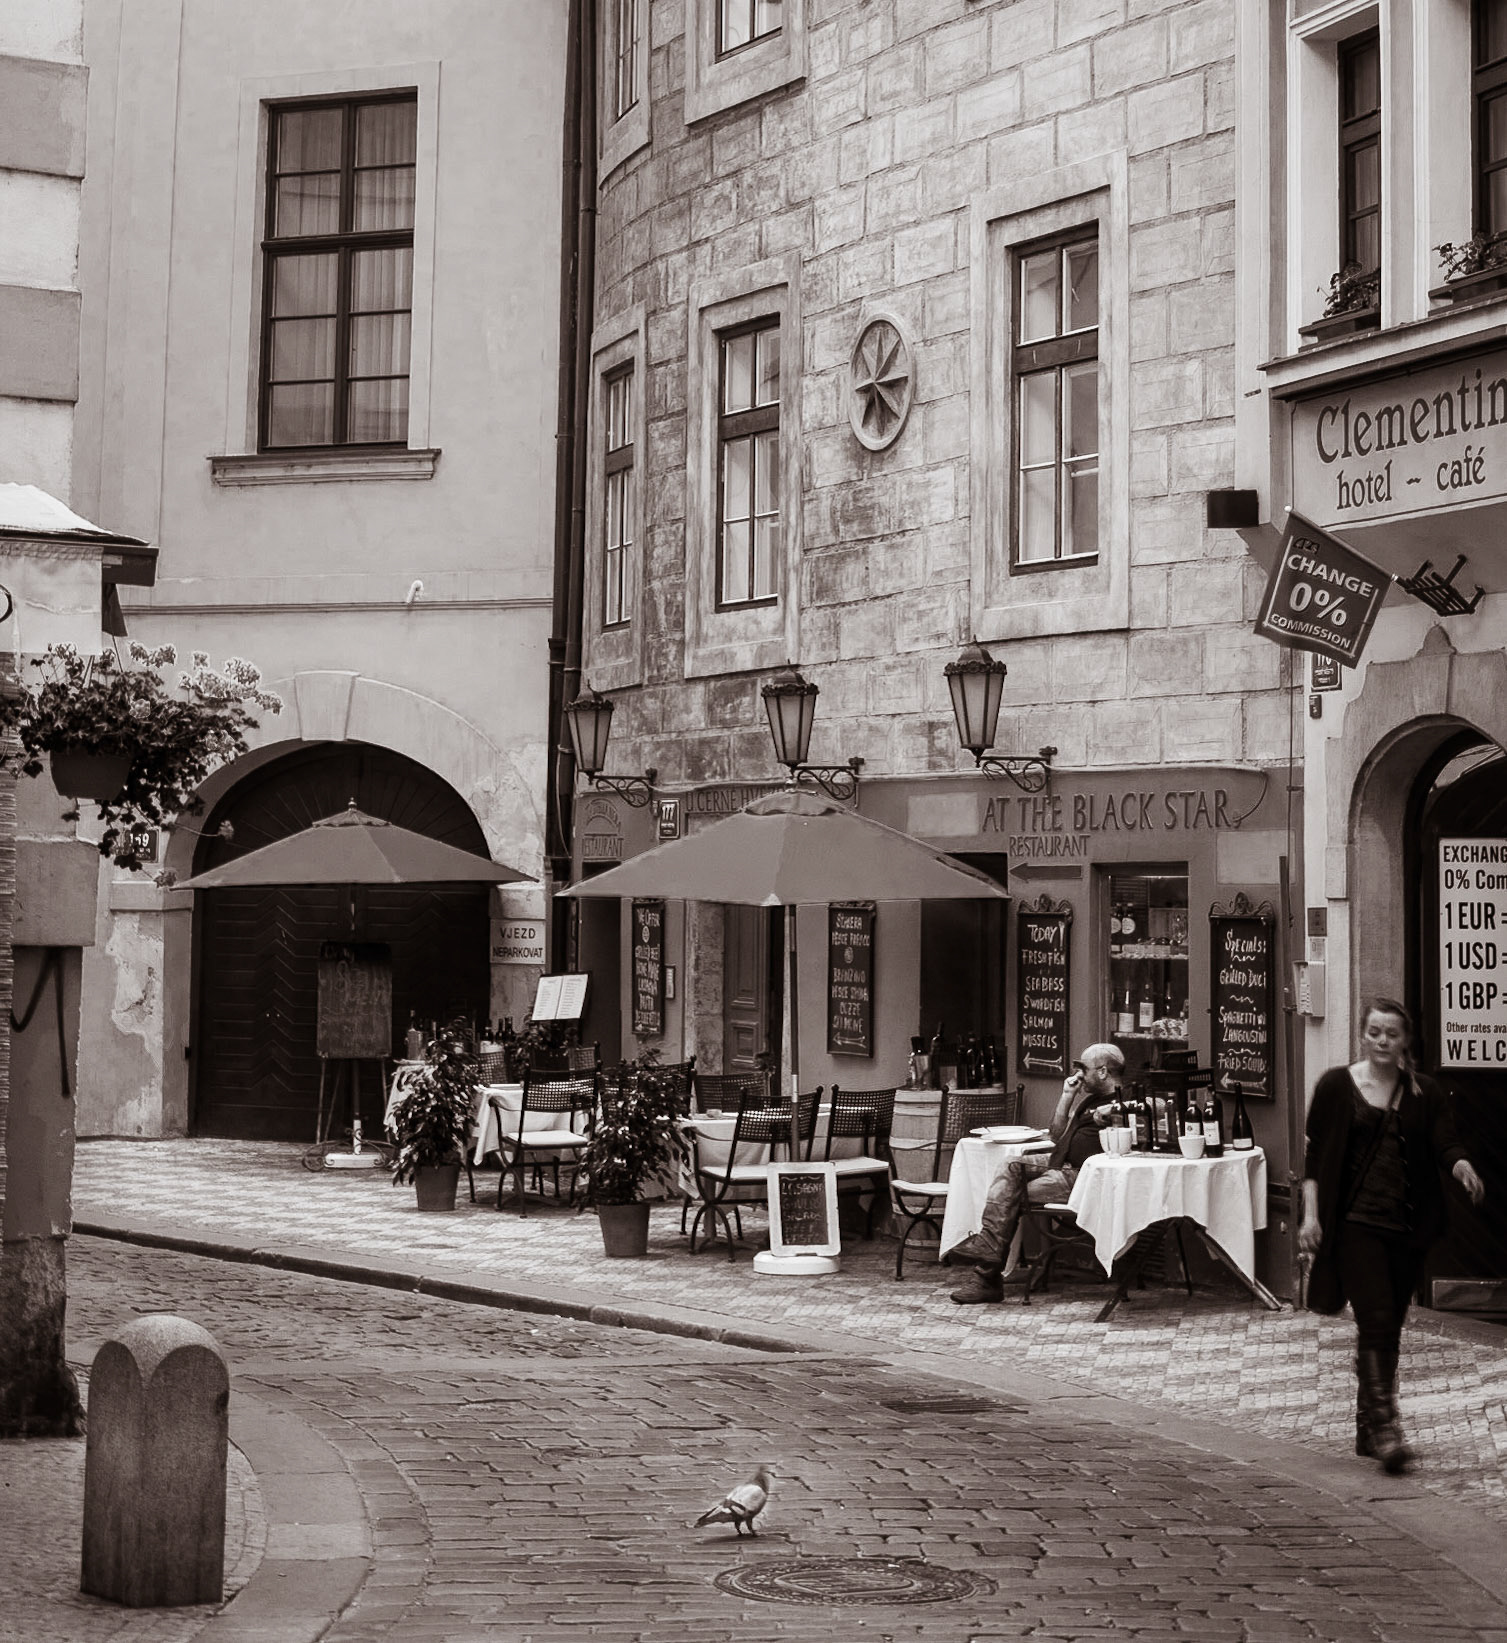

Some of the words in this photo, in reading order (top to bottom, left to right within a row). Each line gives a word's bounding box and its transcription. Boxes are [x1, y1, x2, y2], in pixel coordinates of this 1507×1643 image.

[1316, 369, 1507, 463] Clementin
[1336, 460, 1392, 510] hotel
[1437, 445, 1486, 491] café
[1287, 554, 1373, 597] CHANGE
[1289, 582, 1347, 626] 0%
[1271, 613, 1351, 649] COMMISSION
[983, 797, 1010, 832] AT
[1017, 795, 1063, 832] THE
[1073, 792, 1155, 831] BLACK
[1164, 789, 1232, 830] STAR
[1008, 834, 1091, 857] RESTAURANT
[1443, 845, 1507, 863] EXCHANG
[1445, 869, 1470, 889] 0%
[1445, 902, 1452, 929] 1
[1459, 902, 1497, 929] EUR
[500, 927, 536, 939] VJEZD
[492, 946, 543, 958] NEPARKOVAT
[1445, 942, 1452, 969] 1
[1459, 942, 1497, 969] USD
[1445, 982, 1452, 1009] 1
[1459, 982, 1497, 1009] GBP
[1022, 1013, 1054, 1030] SALMON
[1446, 1021, 1468, 1033] Other
[1471, 1023, 1491, 1034] rates
[1022, 1033, 1058, 1049] MUSSELS
[1447, 1039, 1507, 1062] WELC
[1217, 1053, 1241, 1071] FRIED
